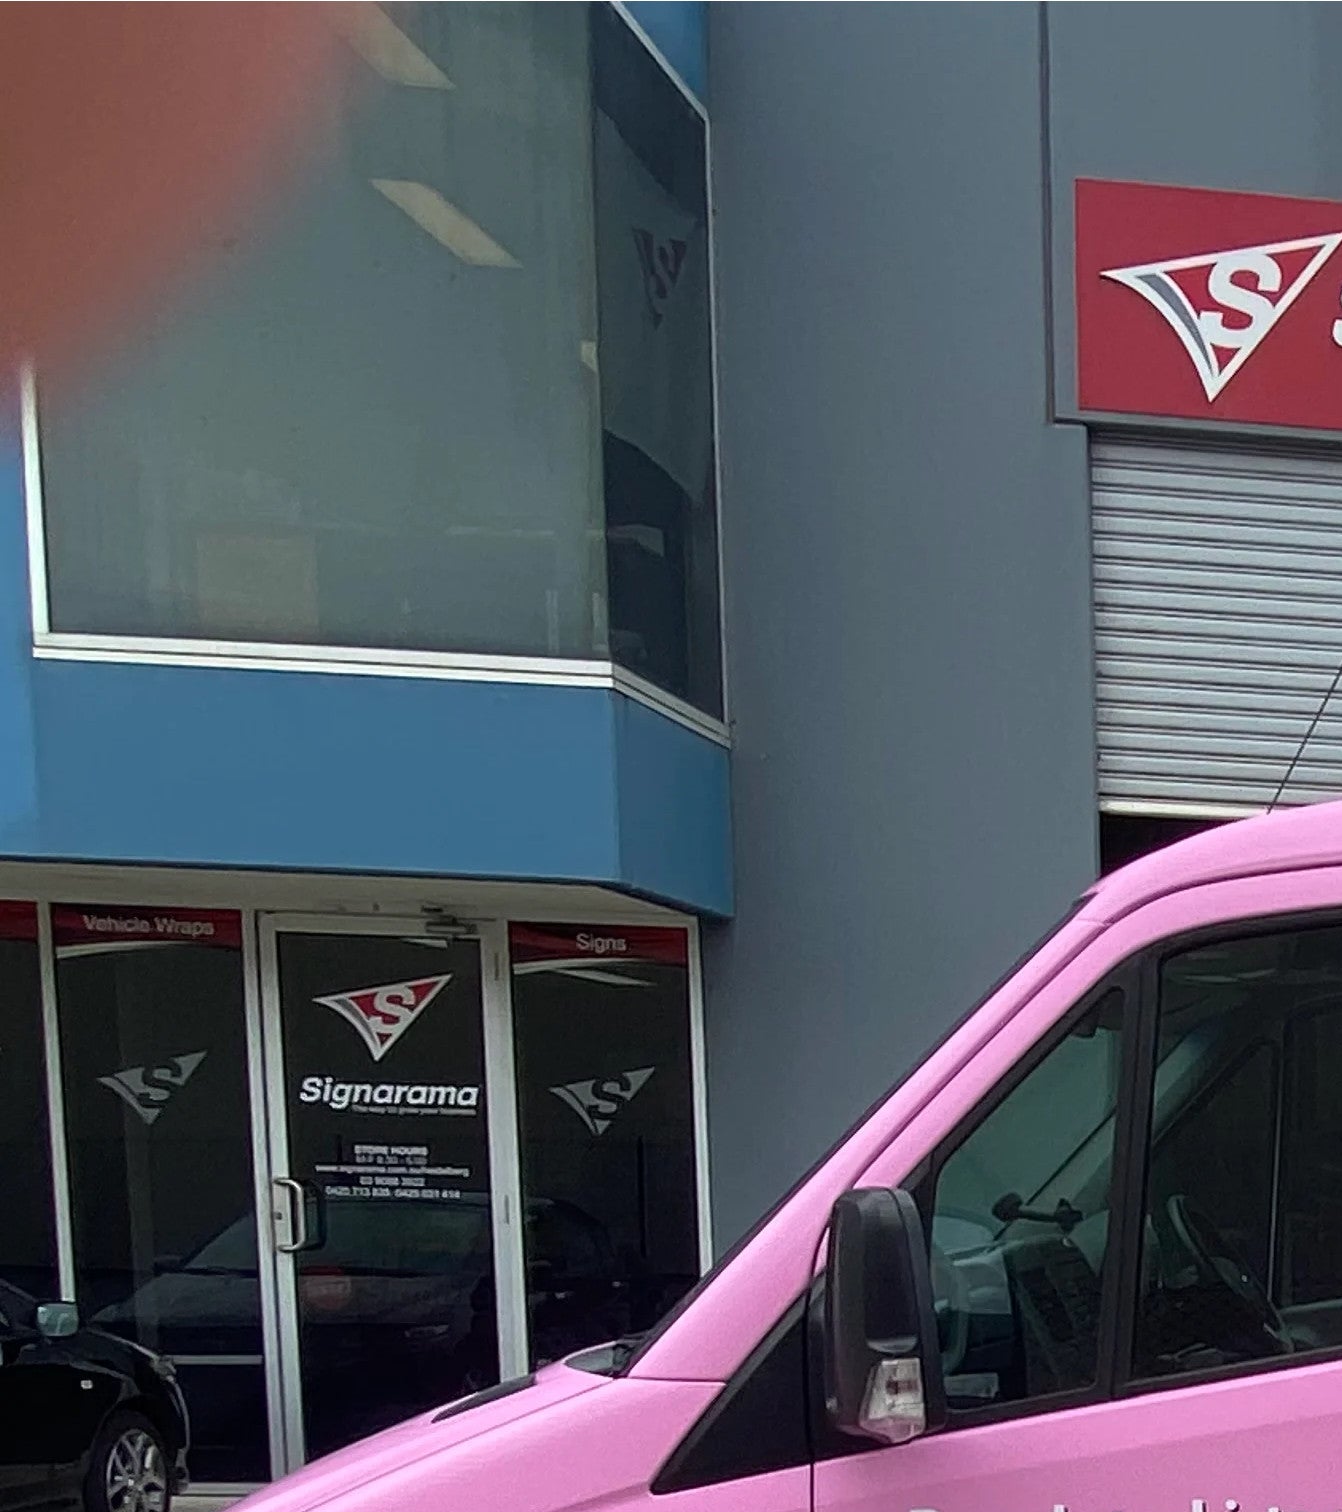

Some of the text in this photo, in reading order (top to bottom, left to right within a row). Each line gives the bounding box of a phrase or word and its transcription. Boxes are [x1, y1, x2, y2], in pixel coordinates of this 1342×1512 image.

[83, 914, 215, 937] Vehicle Wraps
[576, 932, 627, 954] Signs
[300, 1077, 479, 1109] Signarama
